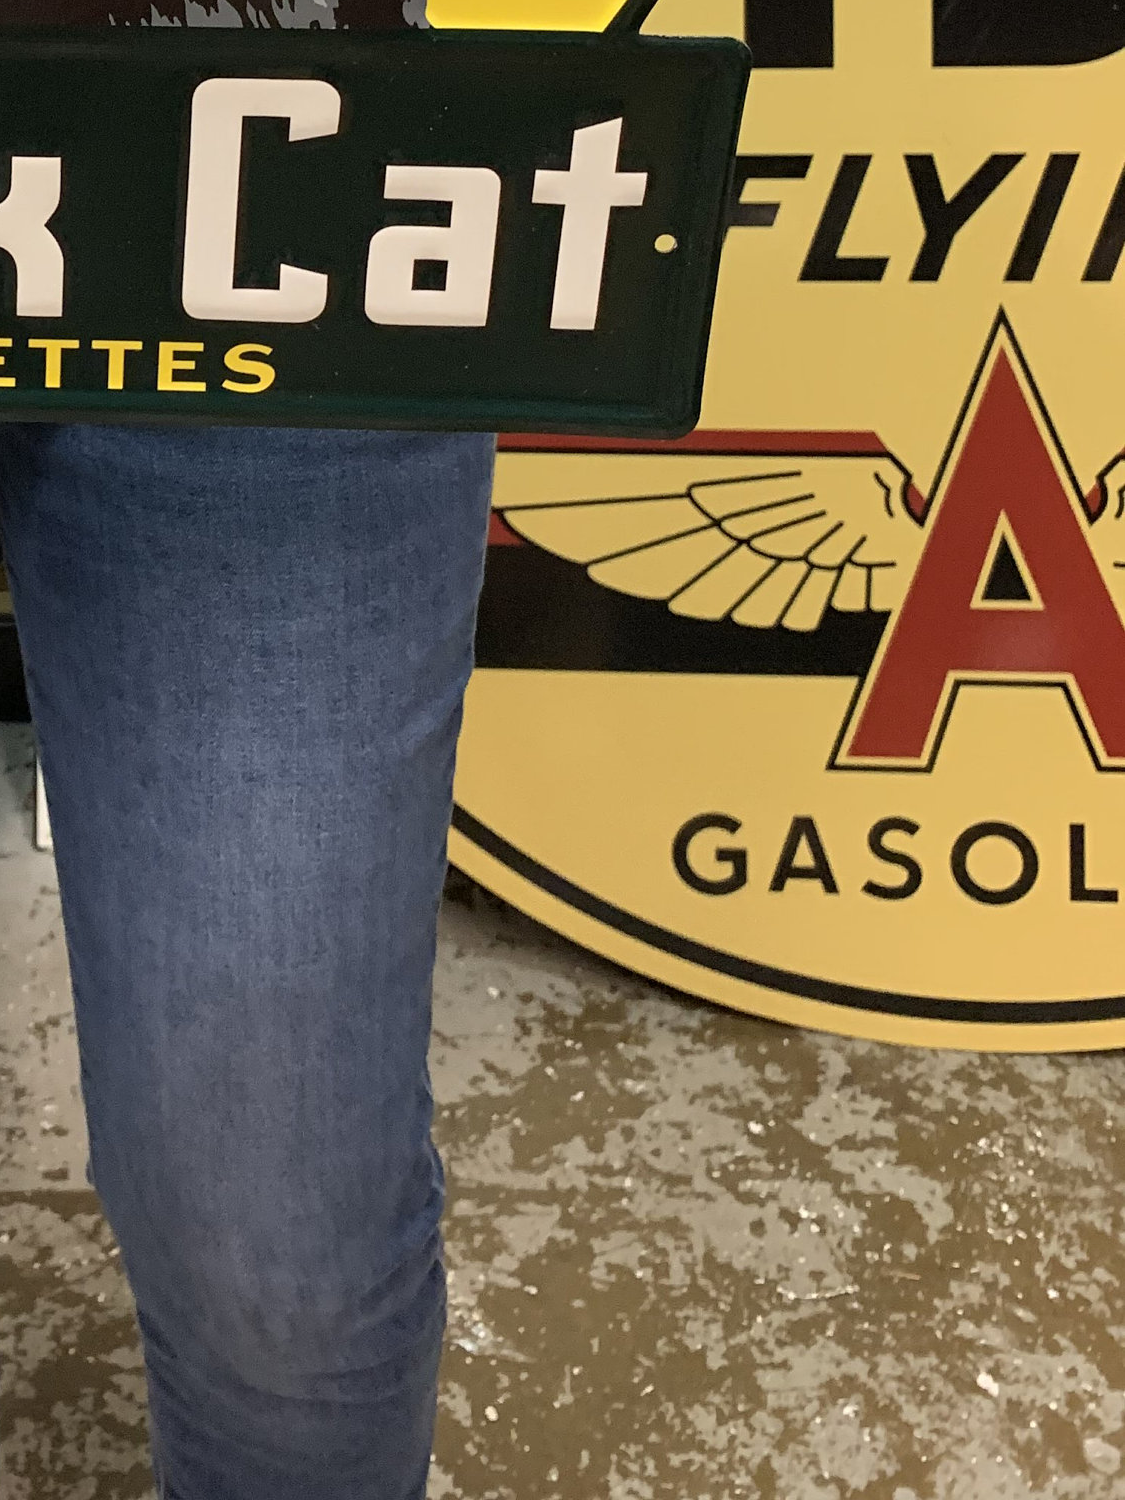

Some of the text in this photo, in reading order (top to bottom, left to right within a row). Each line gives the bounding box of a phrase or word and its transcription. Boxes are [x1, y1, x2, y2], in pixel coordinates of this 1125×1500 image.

[181, 77, 649, 331] Cat
[722, 152, 1125, 283] FLYI
[672, 812, 1119, 905] GASOL
